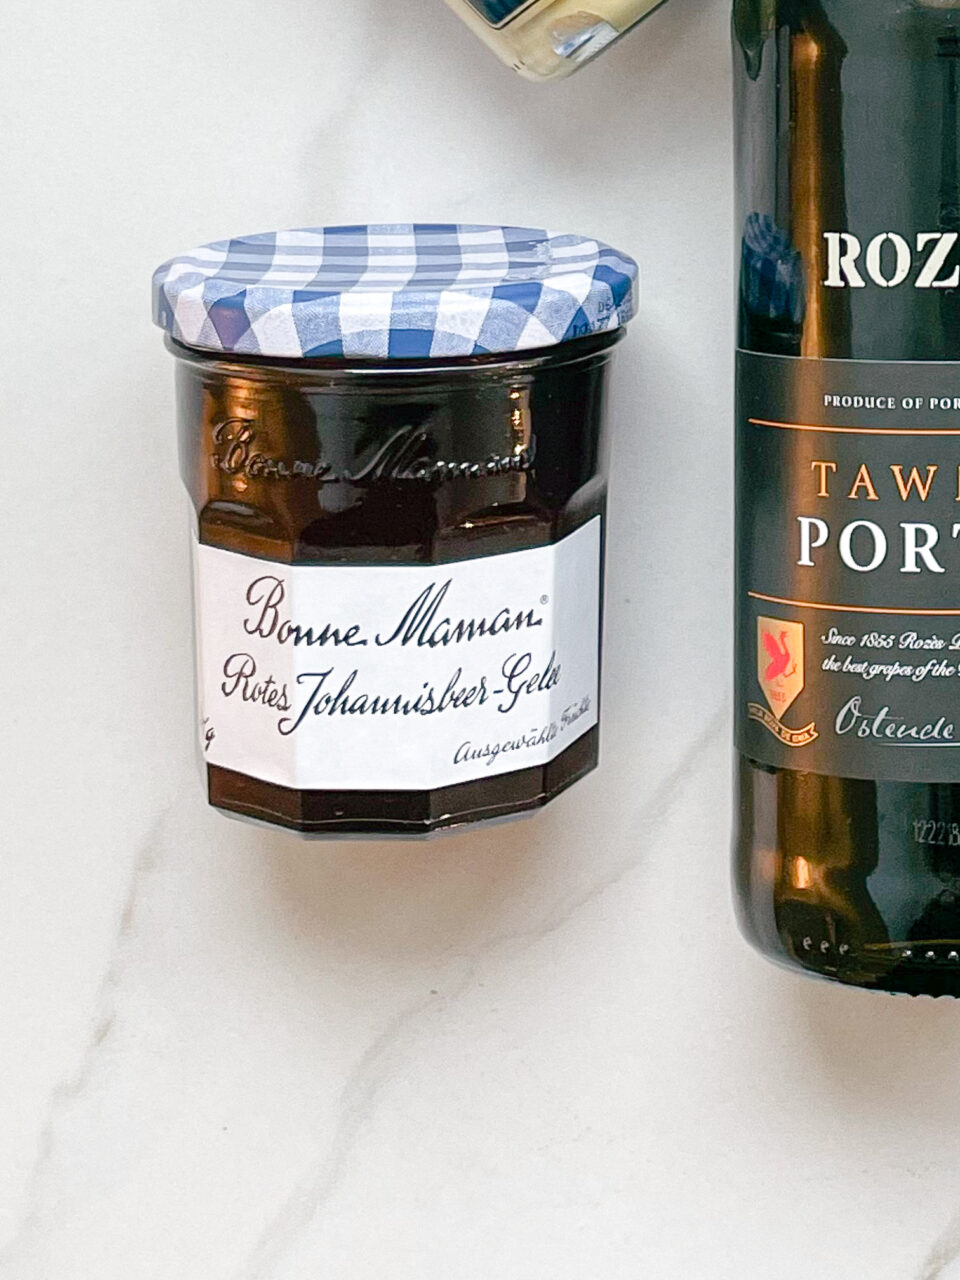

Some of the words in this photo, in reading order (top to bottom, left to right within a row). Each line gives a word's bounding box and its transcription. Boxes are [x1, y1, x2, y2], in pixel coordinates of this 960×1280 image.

[823, 395, 896, 410] PRODUCE
[902, 397, 923, 410] OF
[244, 575, 367, 646] Bonne
[375, 578, 543, 648] Maman
[821, 627, 856, 646] Since
[860, 632, 895, 648] 1855
[899, 631, 946, 649] Rozès
[221, 653, 292, 711] Rotes
[822, 655, 841, 672] the
[842, 655, 870, 673] best
[862, 662, 914, 681] grapes
[912, 660, 937, 681] of
[931, 660, 955, 677] the
[835, 696, 954, 739] Ostende
